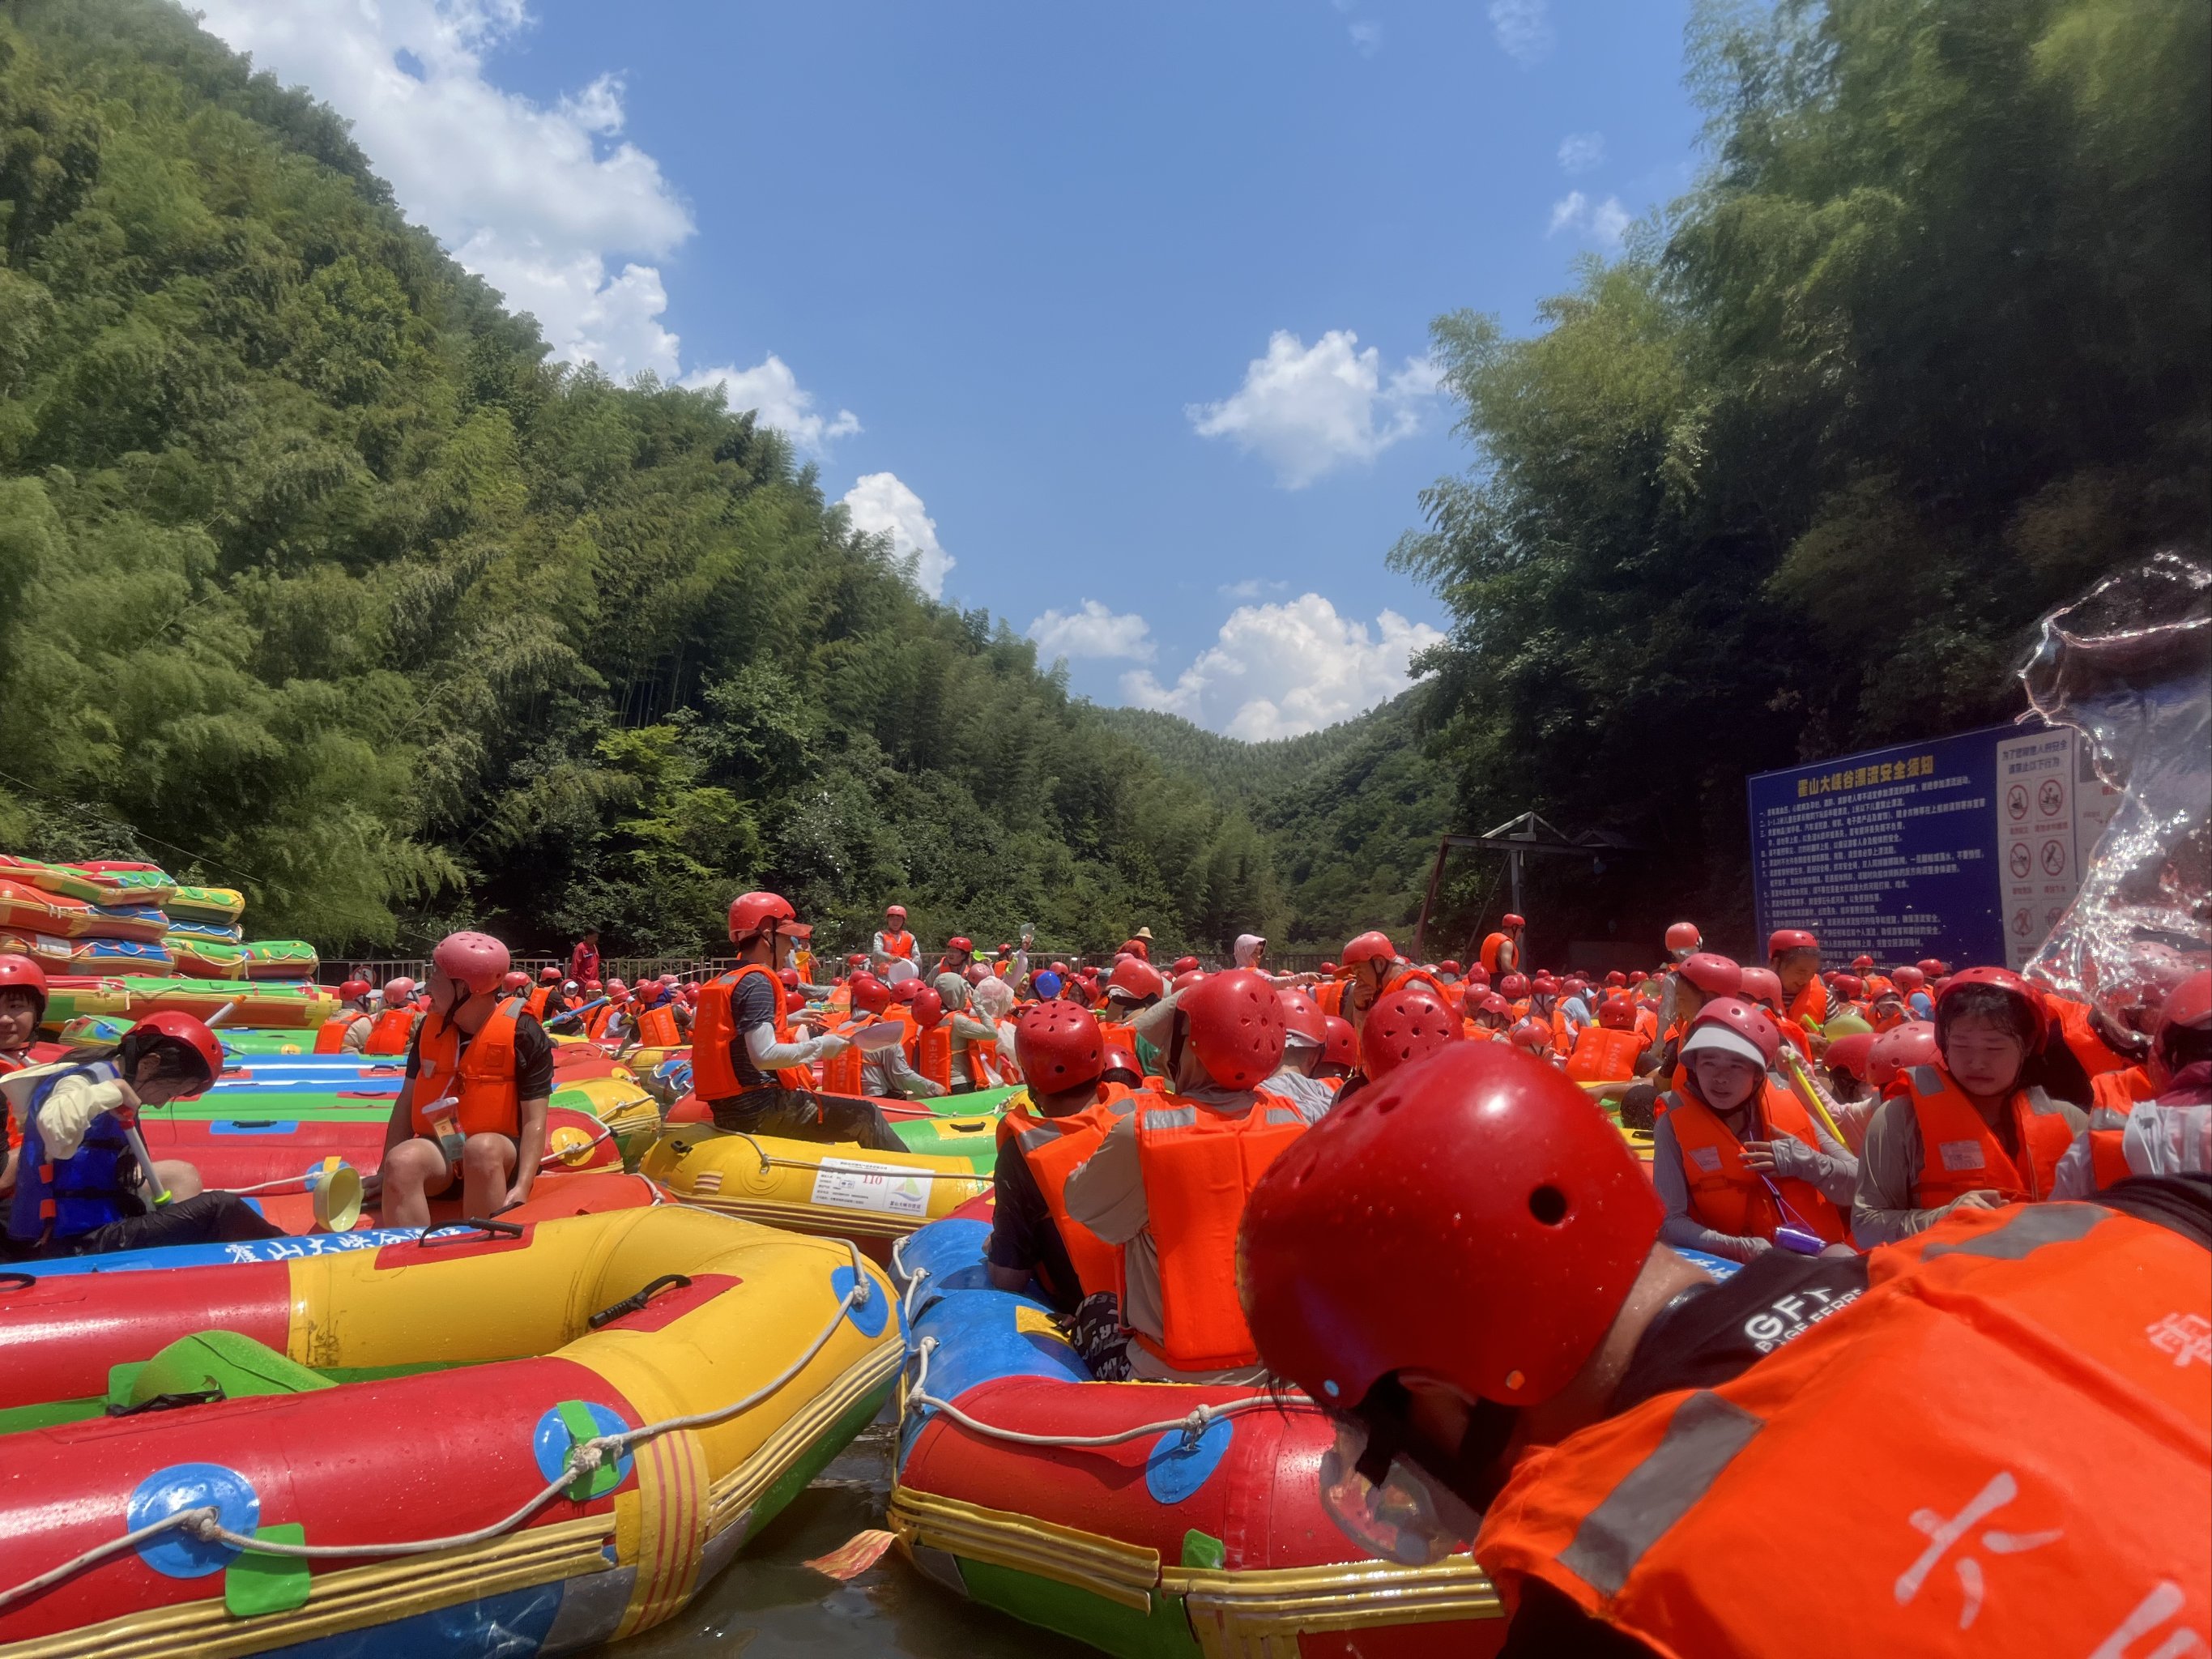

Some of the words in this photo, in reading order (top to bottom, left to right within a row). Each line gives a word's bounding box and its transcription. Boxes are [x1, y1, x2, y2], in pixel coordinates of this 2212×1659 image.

[1798, 755, 1933, 798] 霍山大峡谷漂流安全须知
[863, 1174, 883, 1185] 110
